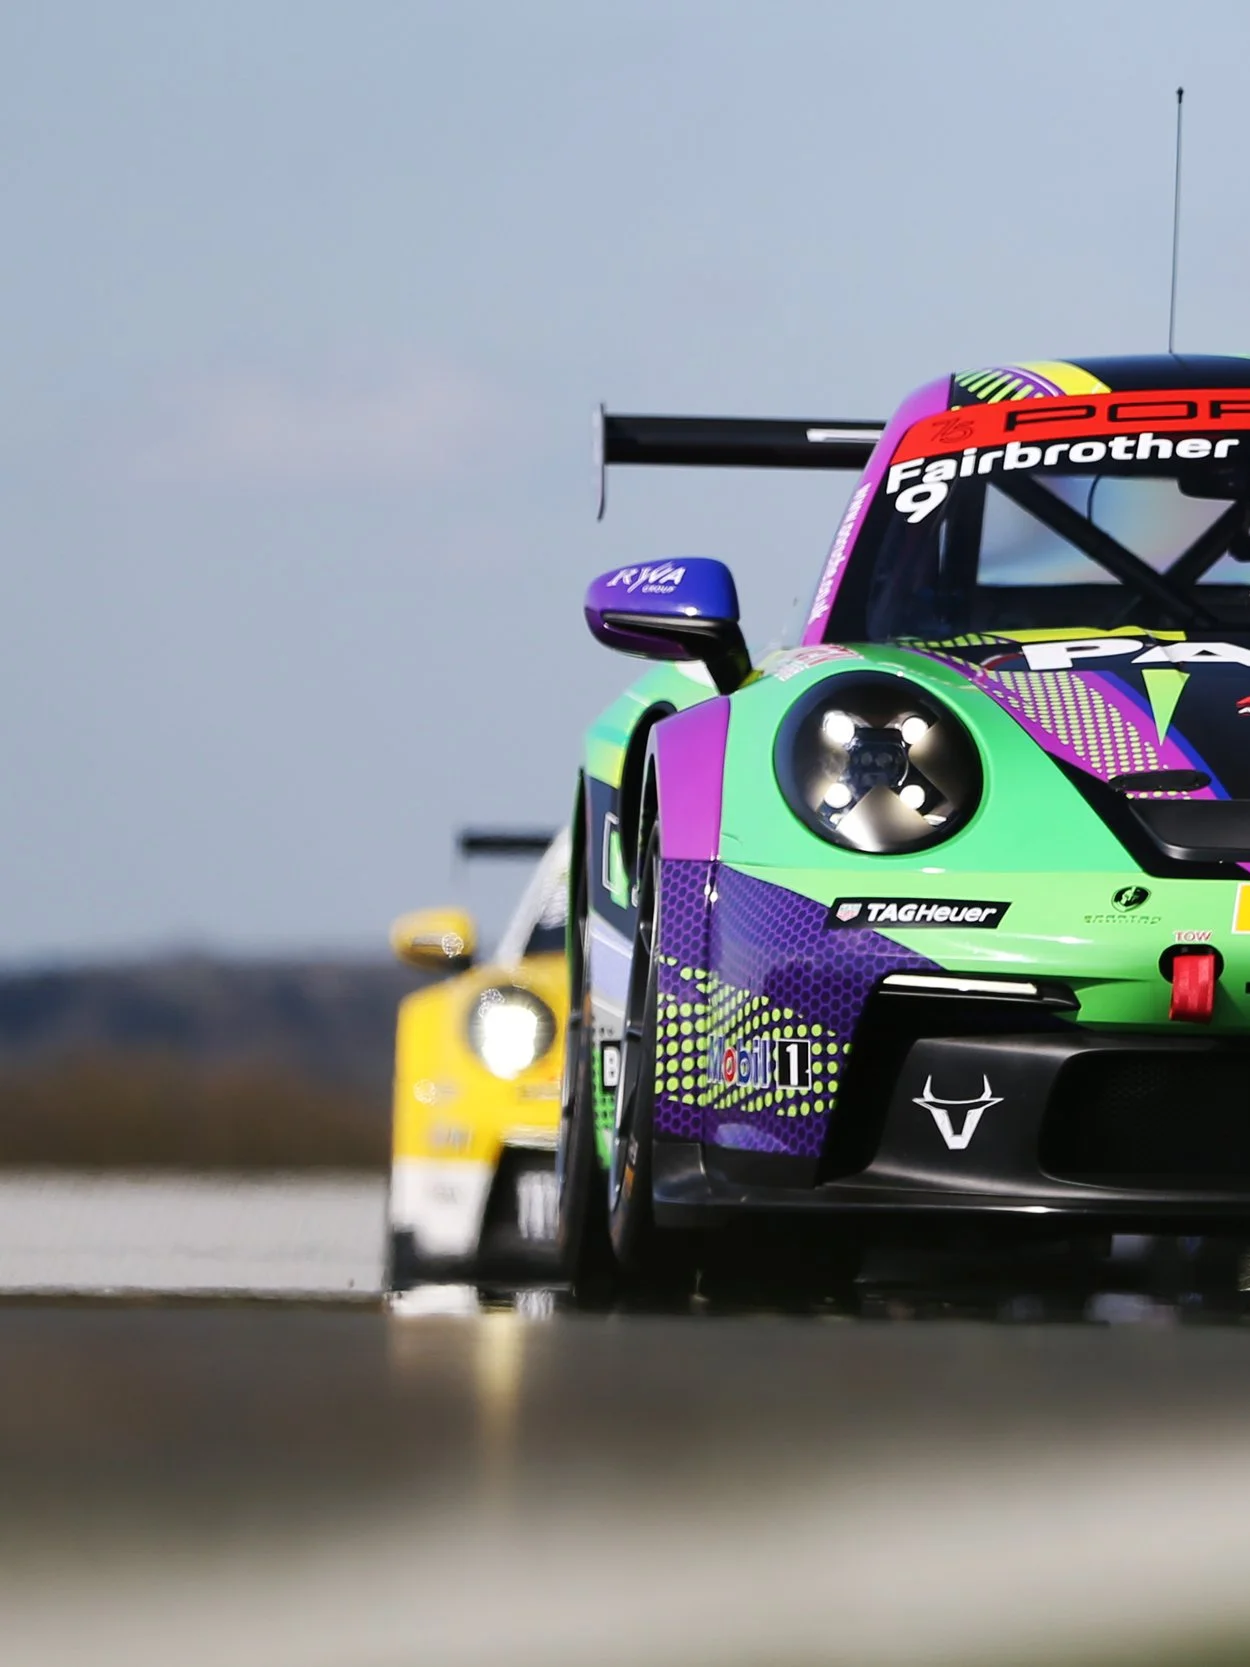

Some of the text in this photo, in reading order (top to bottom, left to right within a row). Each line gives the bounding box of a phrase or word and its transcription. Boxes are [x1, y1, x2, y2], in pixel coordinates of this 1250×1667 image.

[886, 433, 1239, 494] Fairbrother
[894, 481, 948, 523] 9
[1174, 930, 1213, 942] TOW
[706, 1034, 770, 1089] Mobil
